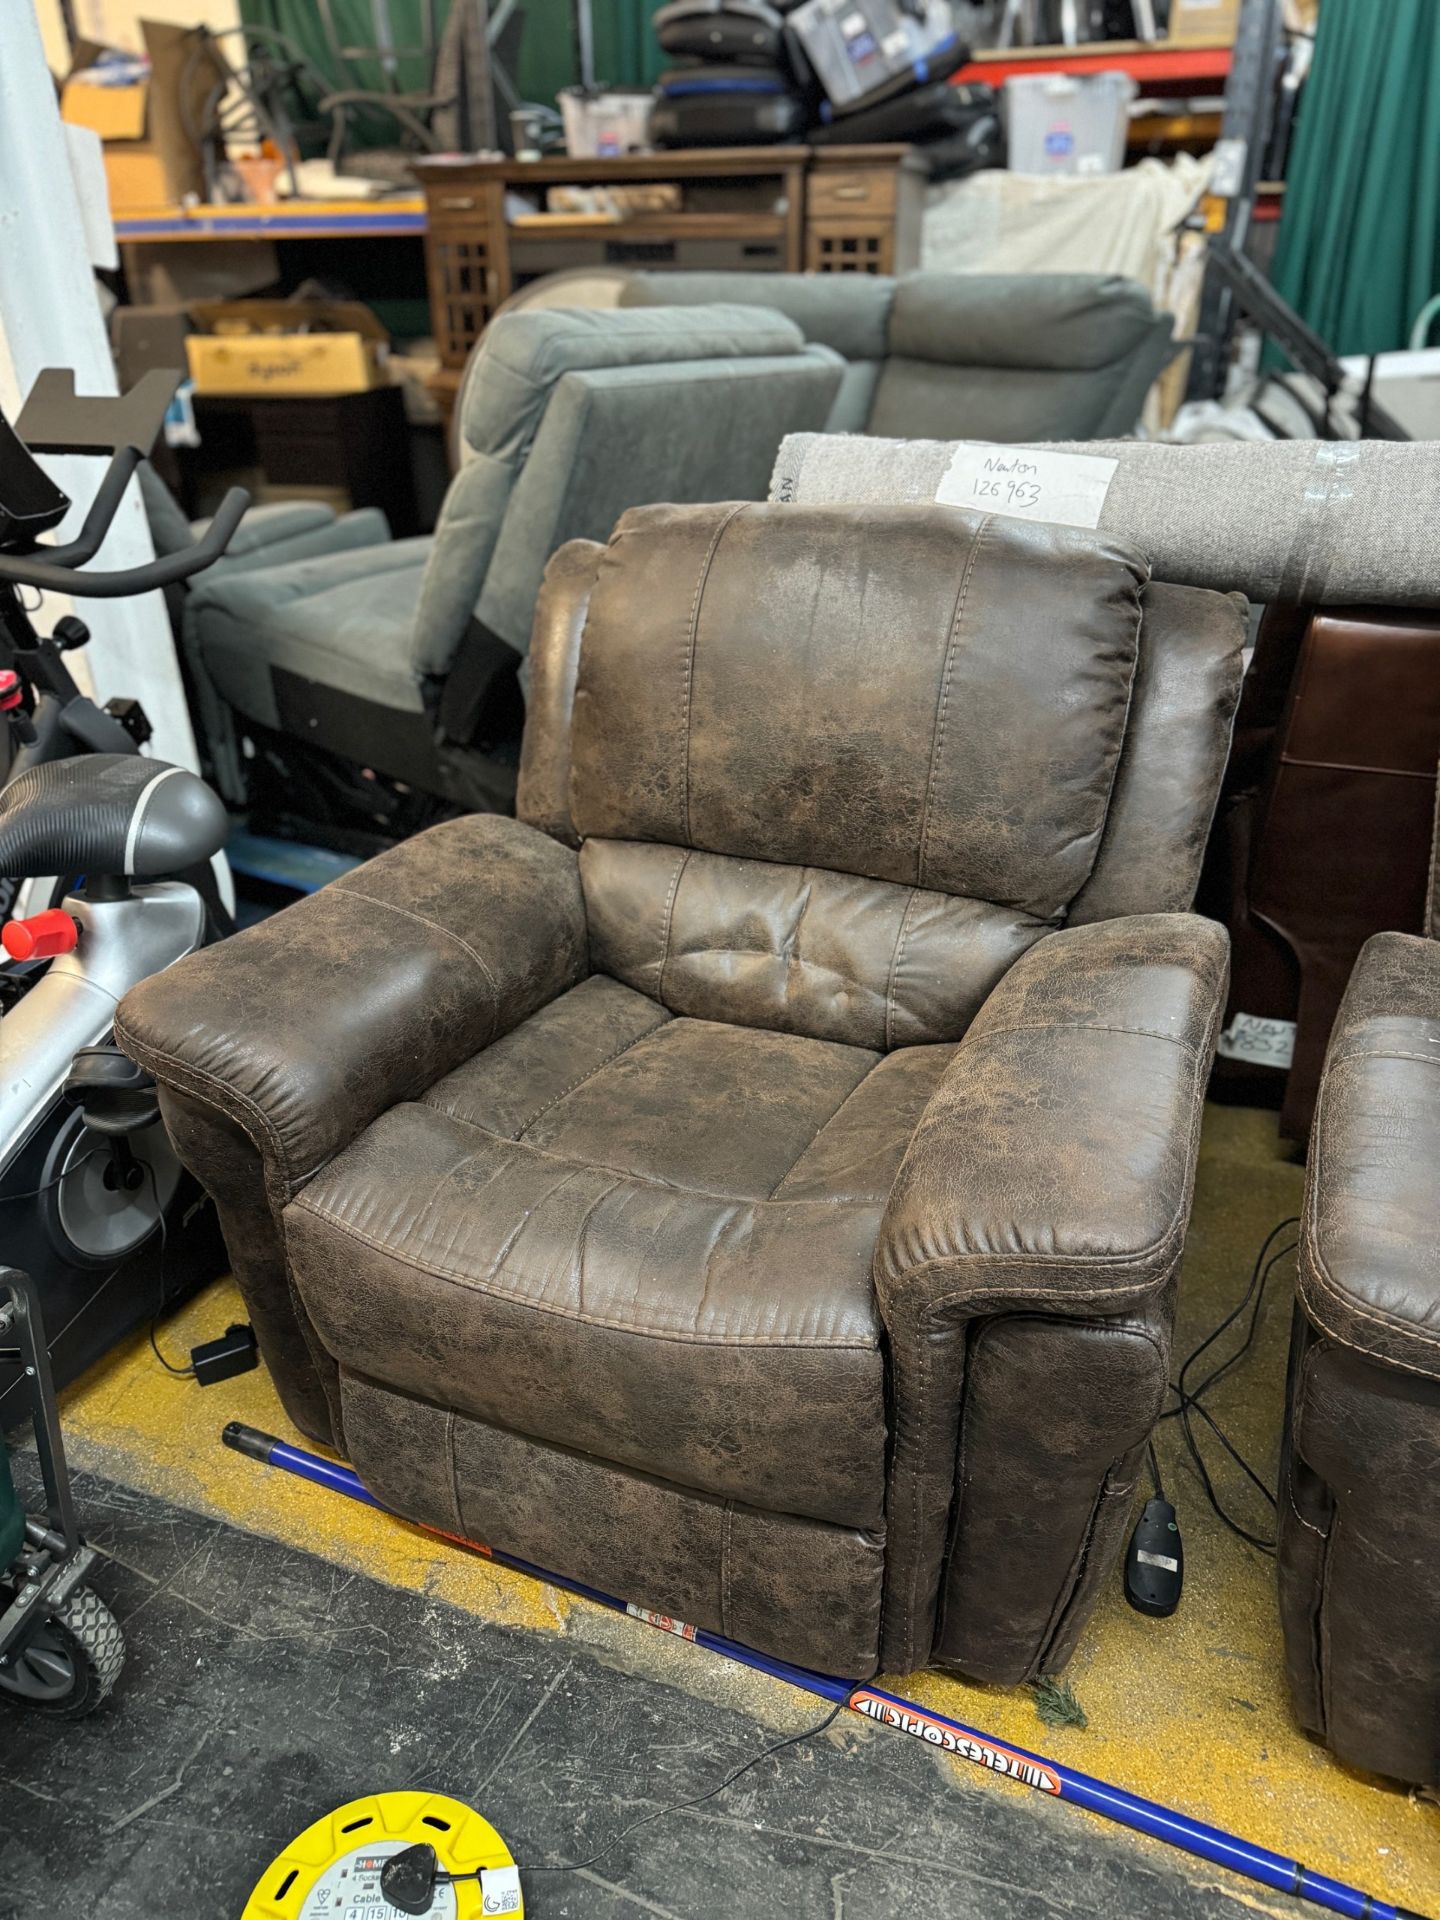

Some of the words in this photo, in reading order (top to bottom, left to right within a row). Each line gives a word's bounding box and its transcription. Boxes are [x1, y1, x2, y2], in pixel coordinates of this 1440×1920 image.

[983, 457, 1038, 476] Newton
[886, 1709, 1022, 1779] TELESCOPIC
[353, 1893, 382, 1904] Cable
[349, 1909, 358, 1919] 4
[370, 1907, 385, 1920] 15
